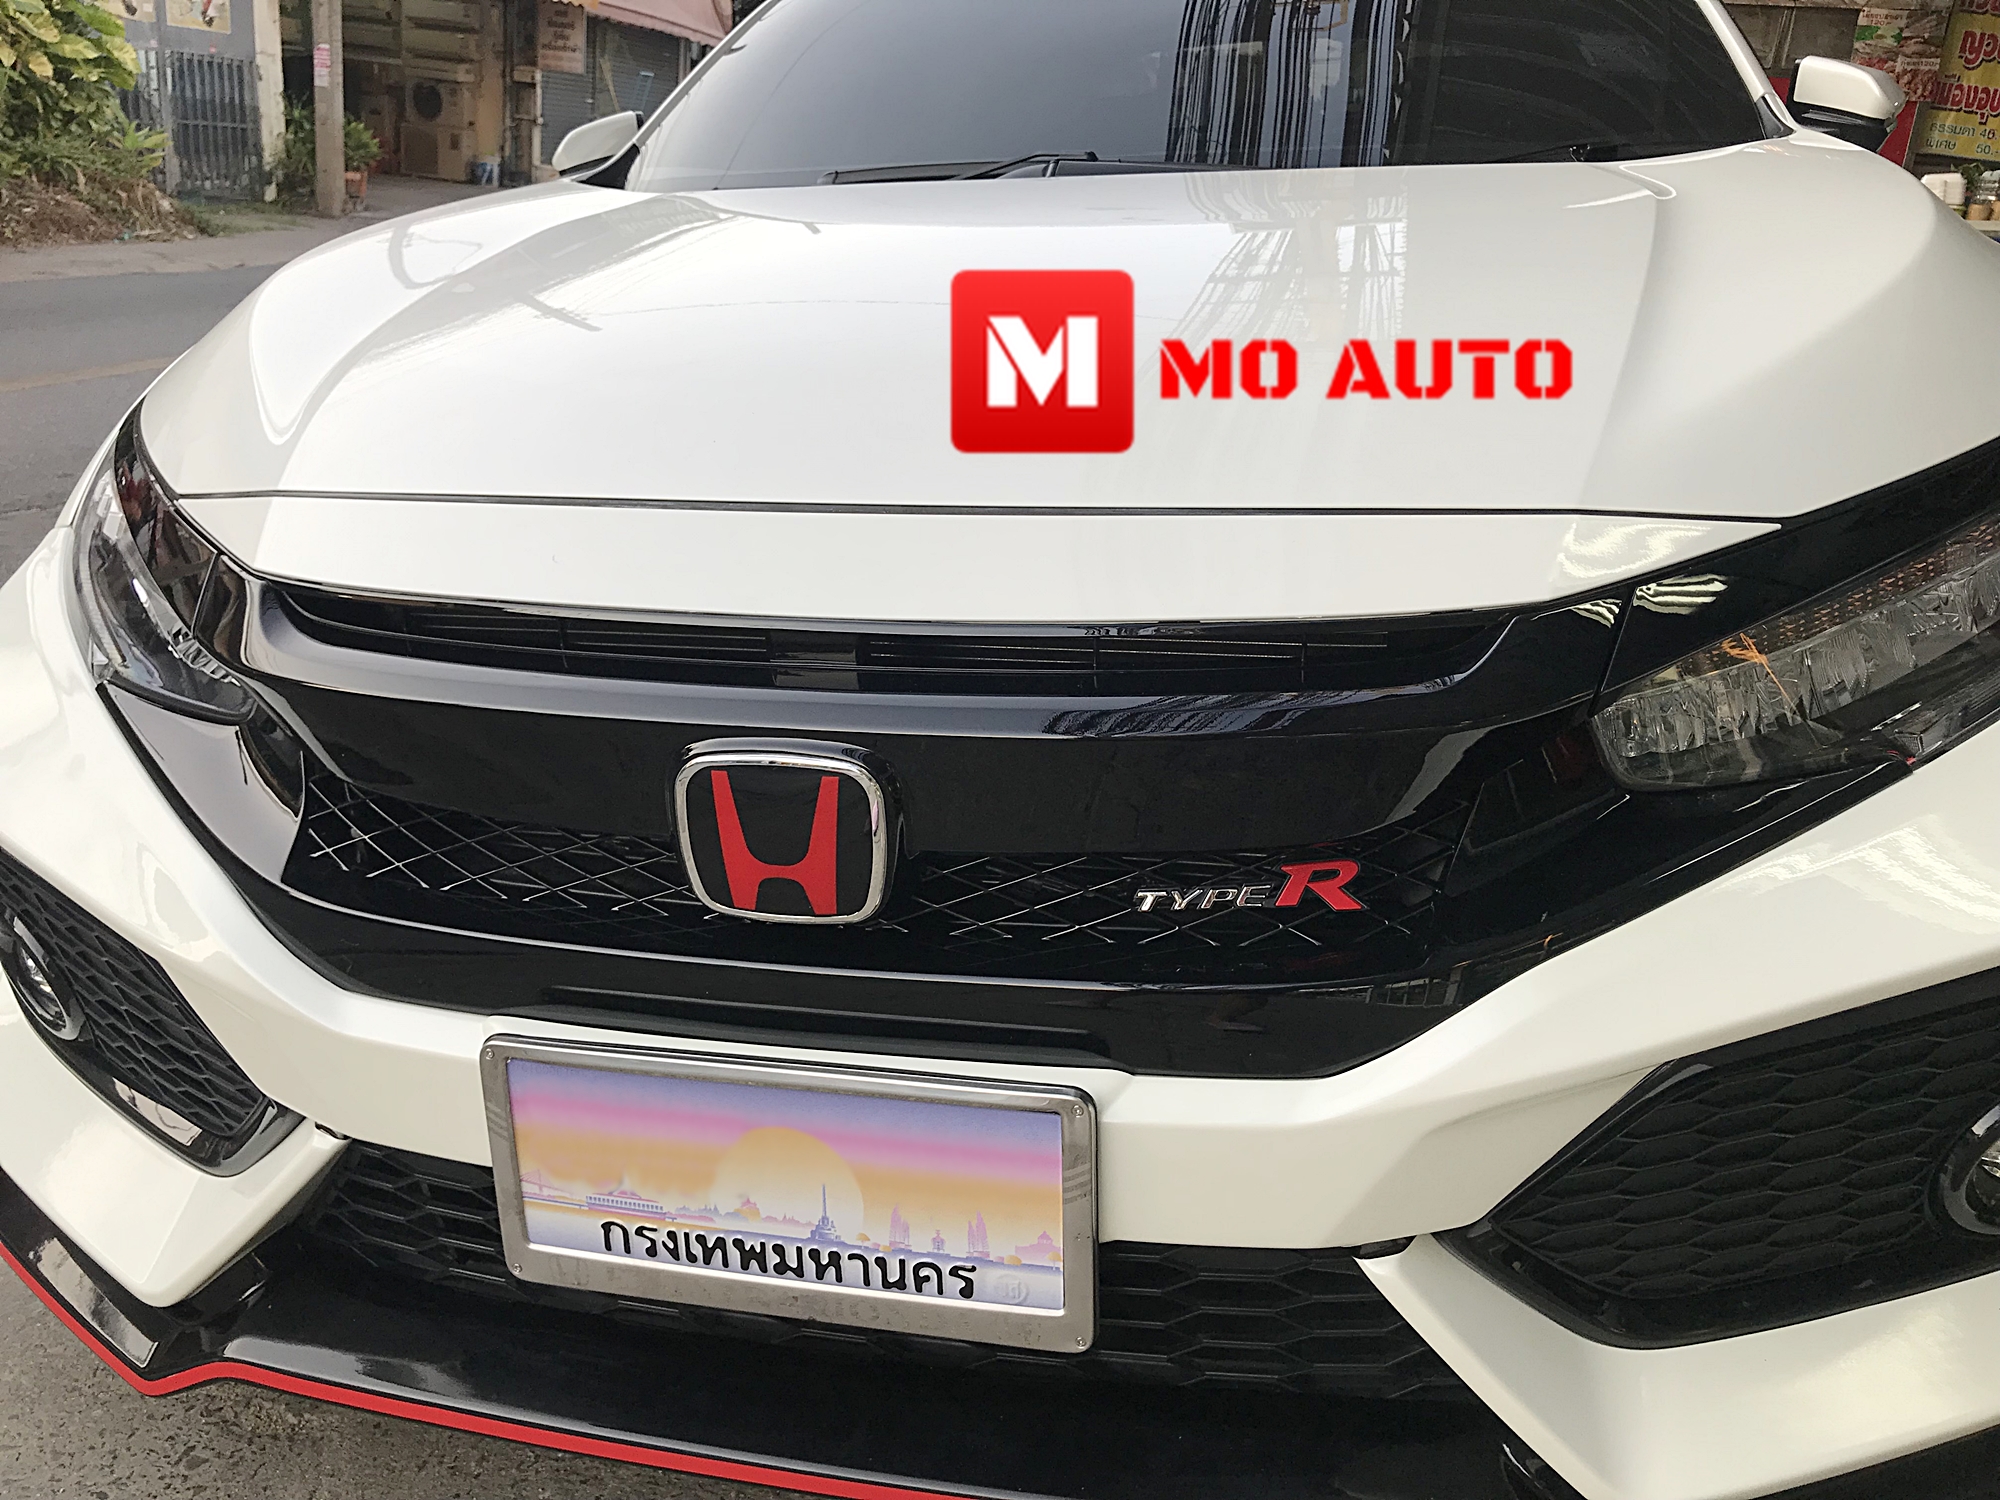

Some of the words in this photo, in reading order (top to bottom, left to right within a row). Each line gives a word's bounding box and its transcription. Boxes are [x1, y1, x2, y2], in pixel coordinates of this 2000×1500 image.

[1958, 29, 2000, 70] ญว
[1929, 122, 1976, 137] ธรรมดา
[1134, 884, 1272, 913] TYPE
[1275, 859, 1362, 911] R
[600, 1220, 978, 1299] กรงเทพมหานคร
